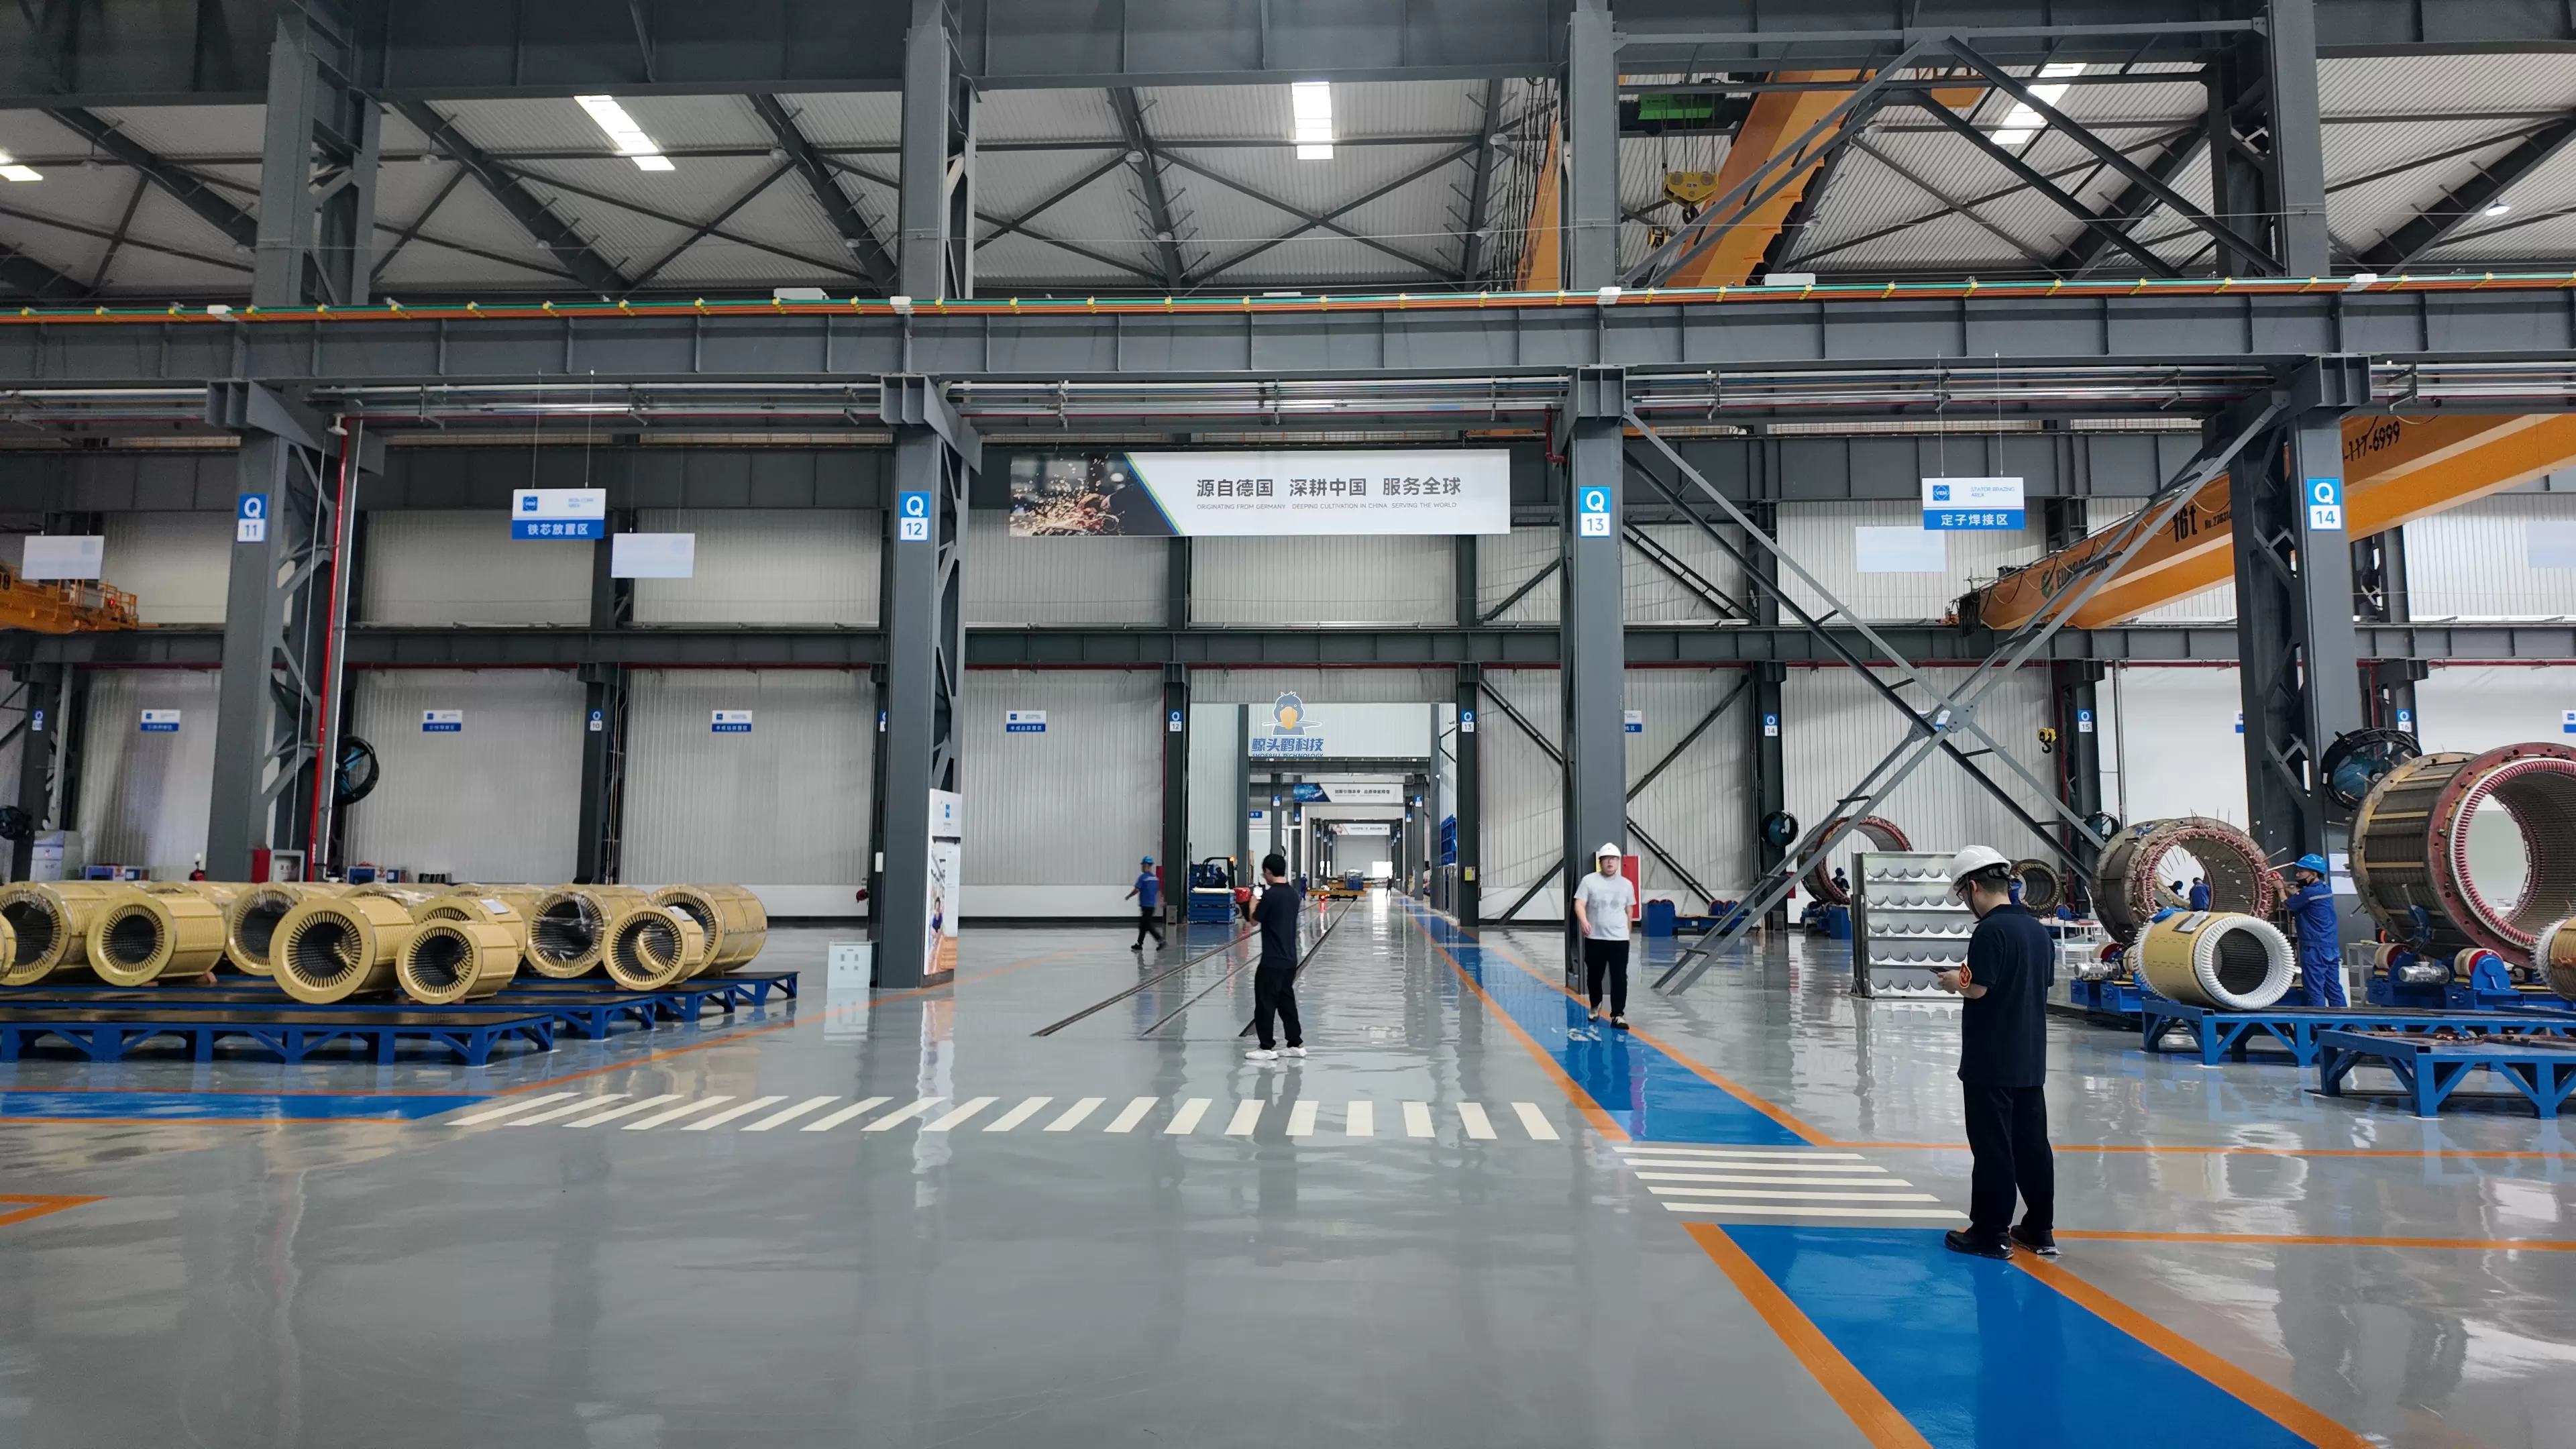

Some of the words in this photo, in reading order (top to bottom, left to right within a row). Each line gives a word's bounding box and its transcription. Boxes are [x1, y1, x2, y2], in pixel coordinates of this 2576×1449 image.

[1197, 478, 1273, 497] 源自德国
[1289, 478, 1366, 496] 深耕中国
[1383, 477, 1461, 496] 服务全球
[2314, 482, 2333, 504] Q
[244, 498, 262, 519] Q
[906, 496, 924, 517] Q
[1587, 491, 1604, 513] Q
[1941, 514, 2008, 526] 定子焊接区
[2316, 511, 2335, 524] 14
[245, 525, 258, 537] 11
[527, 523, 588, 535] 铁芯放置区
[906, 523, 923, 535] 12
[1587, 518, 1604, 531] 13
[1252, 738, 1324, 752] 鲸头鹳科技
